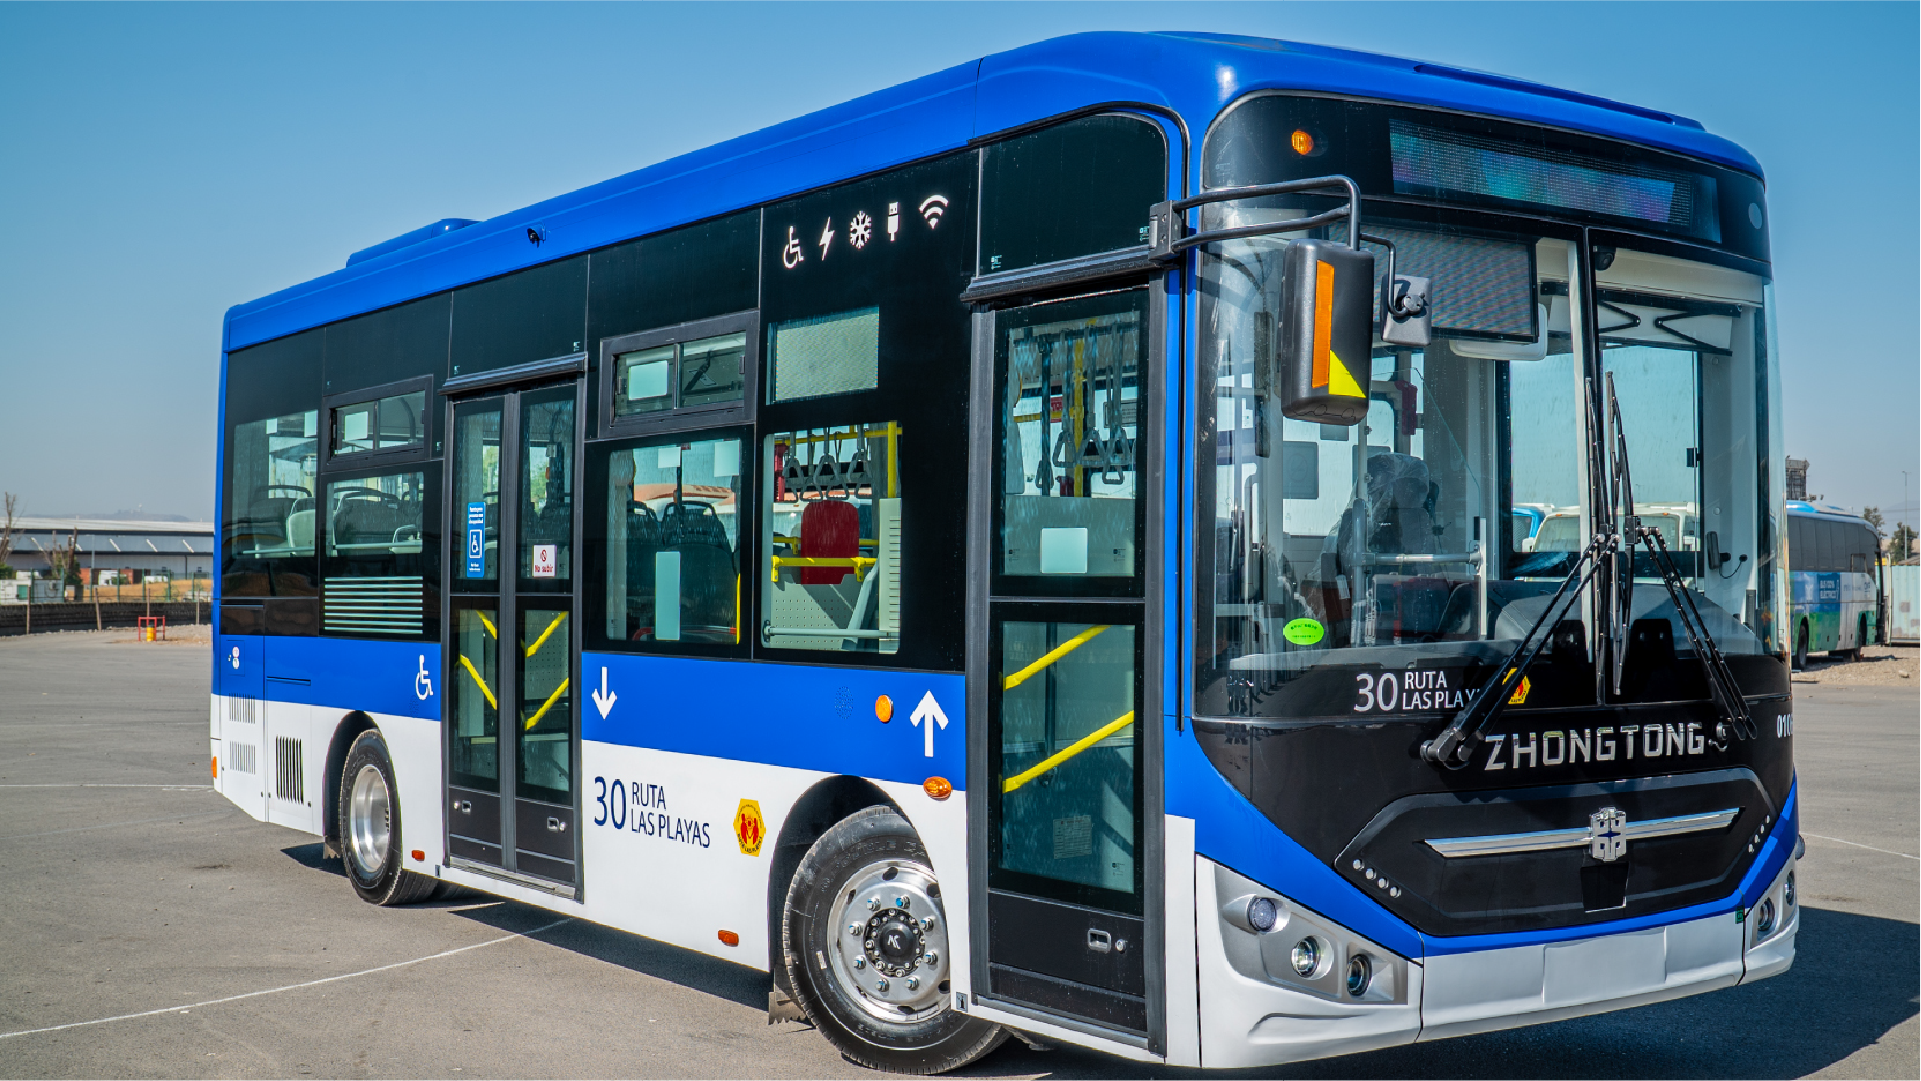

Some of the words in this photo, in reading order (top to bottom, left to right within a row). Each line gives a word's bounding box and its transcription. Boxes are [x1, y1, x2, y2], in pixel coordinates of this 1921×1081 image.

[1353, 672, 1399, 712] 30
[1402, 691, 1432, 710] LAS
[1434, 688, 1480, 709] PLAY
[1404, 671, 1448, 690] RUTA
[1484, 722, 1705, 771] ZHONGTONG
[594, 776, 627, 829] 30
[632, 781, 666, 810] RUTA
[631, 808, 655, 836] LAS
[658, 814, 711, 849] PLAYAS
